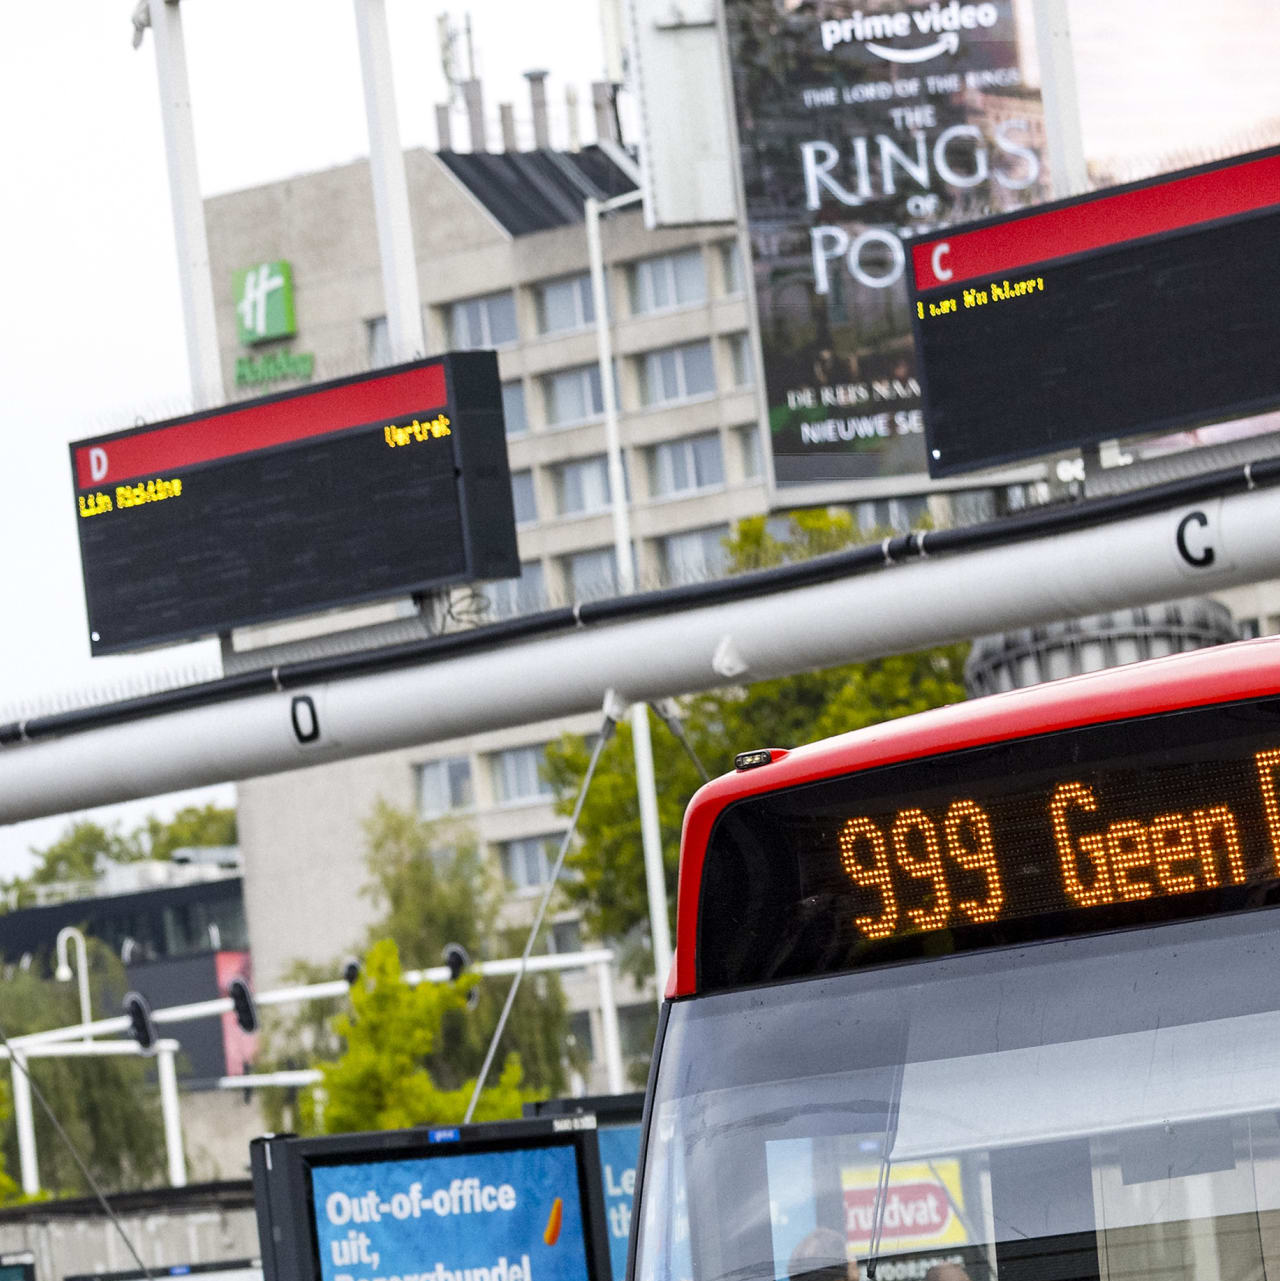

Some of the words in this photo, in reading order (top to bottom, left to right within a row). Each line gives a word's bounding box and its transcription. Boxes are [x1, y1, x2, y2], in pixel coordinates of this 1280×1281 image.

[821, 10, 912, 51] prime
[913, 1, 998, 35] video
[889, 104, 937, 131] THE
[800, 119, 1041, 211] RINGS
[810, 224, 907, 294] PO
[931, 243, 953, 281] C
[800, 410, 893, 444] NIEUWE
[893, 408, 924, 435] SE
[90, 447, 108, 482] D
[1175, 510, 1217, 567] C
[290, 694, 320, 743] D
[838, 800, 1005, 938] 999
[1050, 782, 1247, 907] Geen
[326, 1178, 516, 1226] Out-of-office
[330, 1229, 379, 1271] uit,
